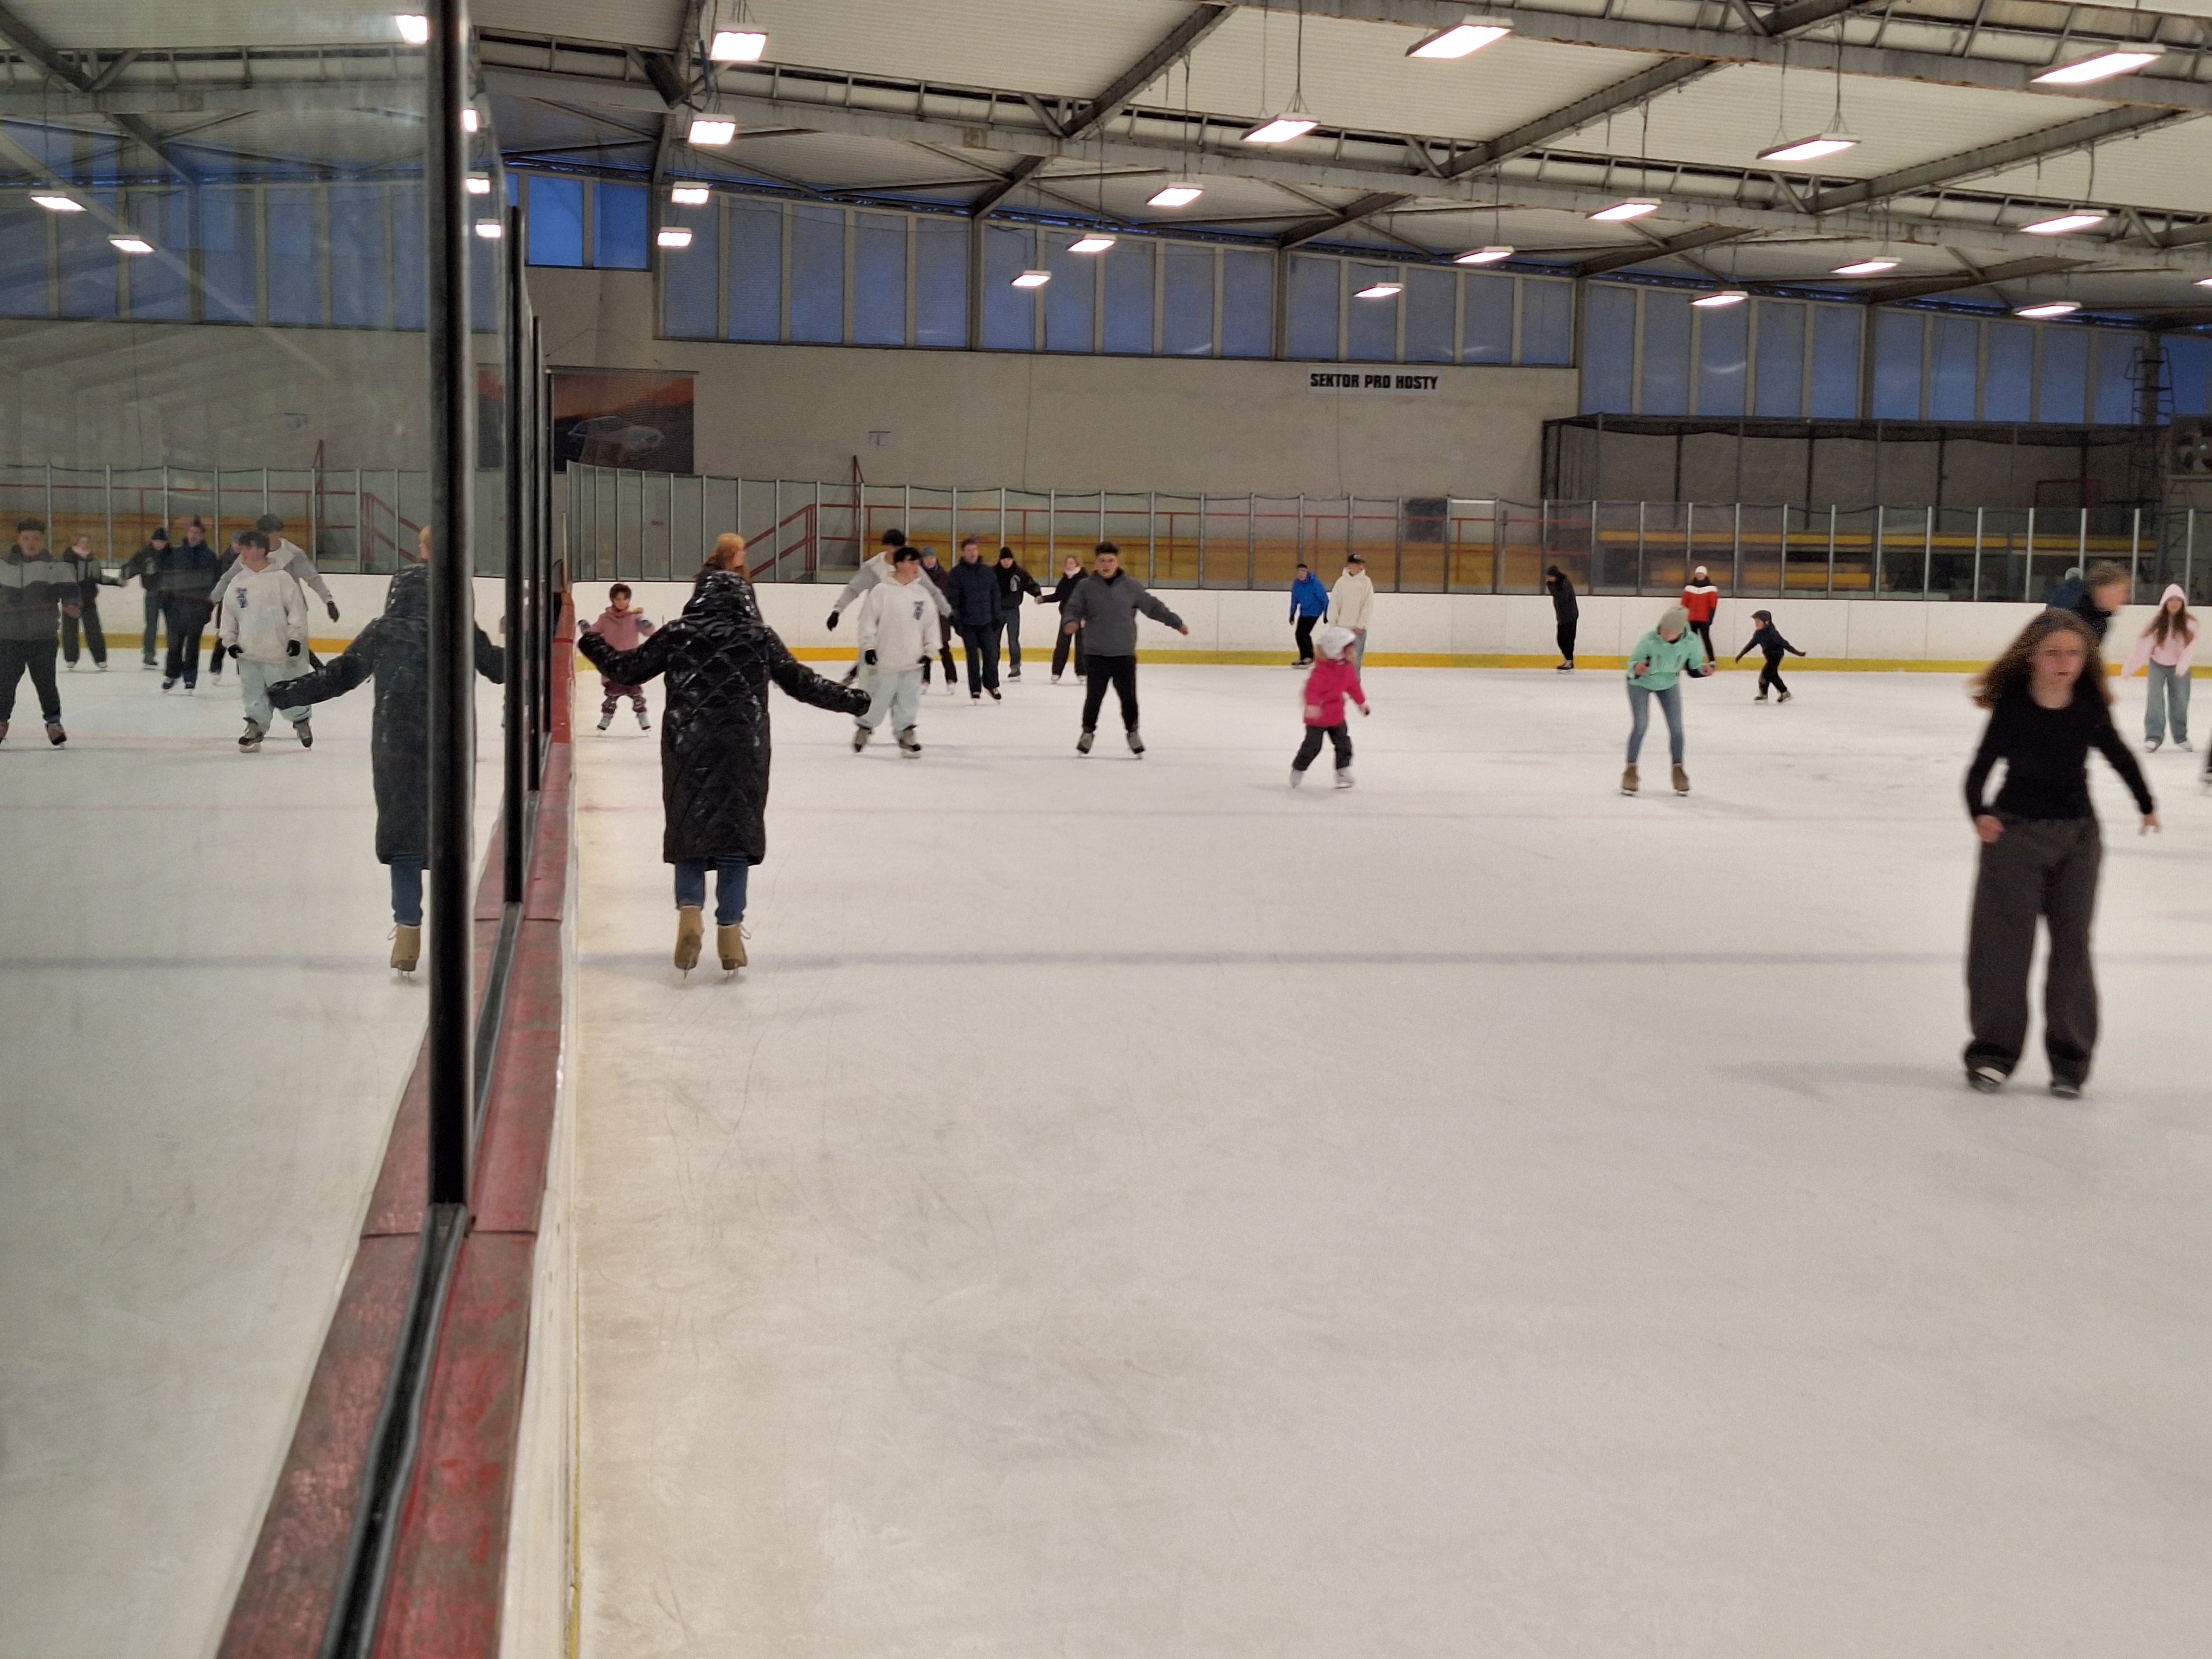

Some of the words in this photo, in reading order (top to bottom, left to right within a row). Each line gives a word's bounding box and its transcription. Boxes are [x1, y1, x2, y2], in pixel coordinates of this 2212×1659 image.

[1310, 373, 1359, 388] SEKTOR
[1364, 374, 1391, 388] PRO
[1396, 375, 1438, 389] HOSTY
